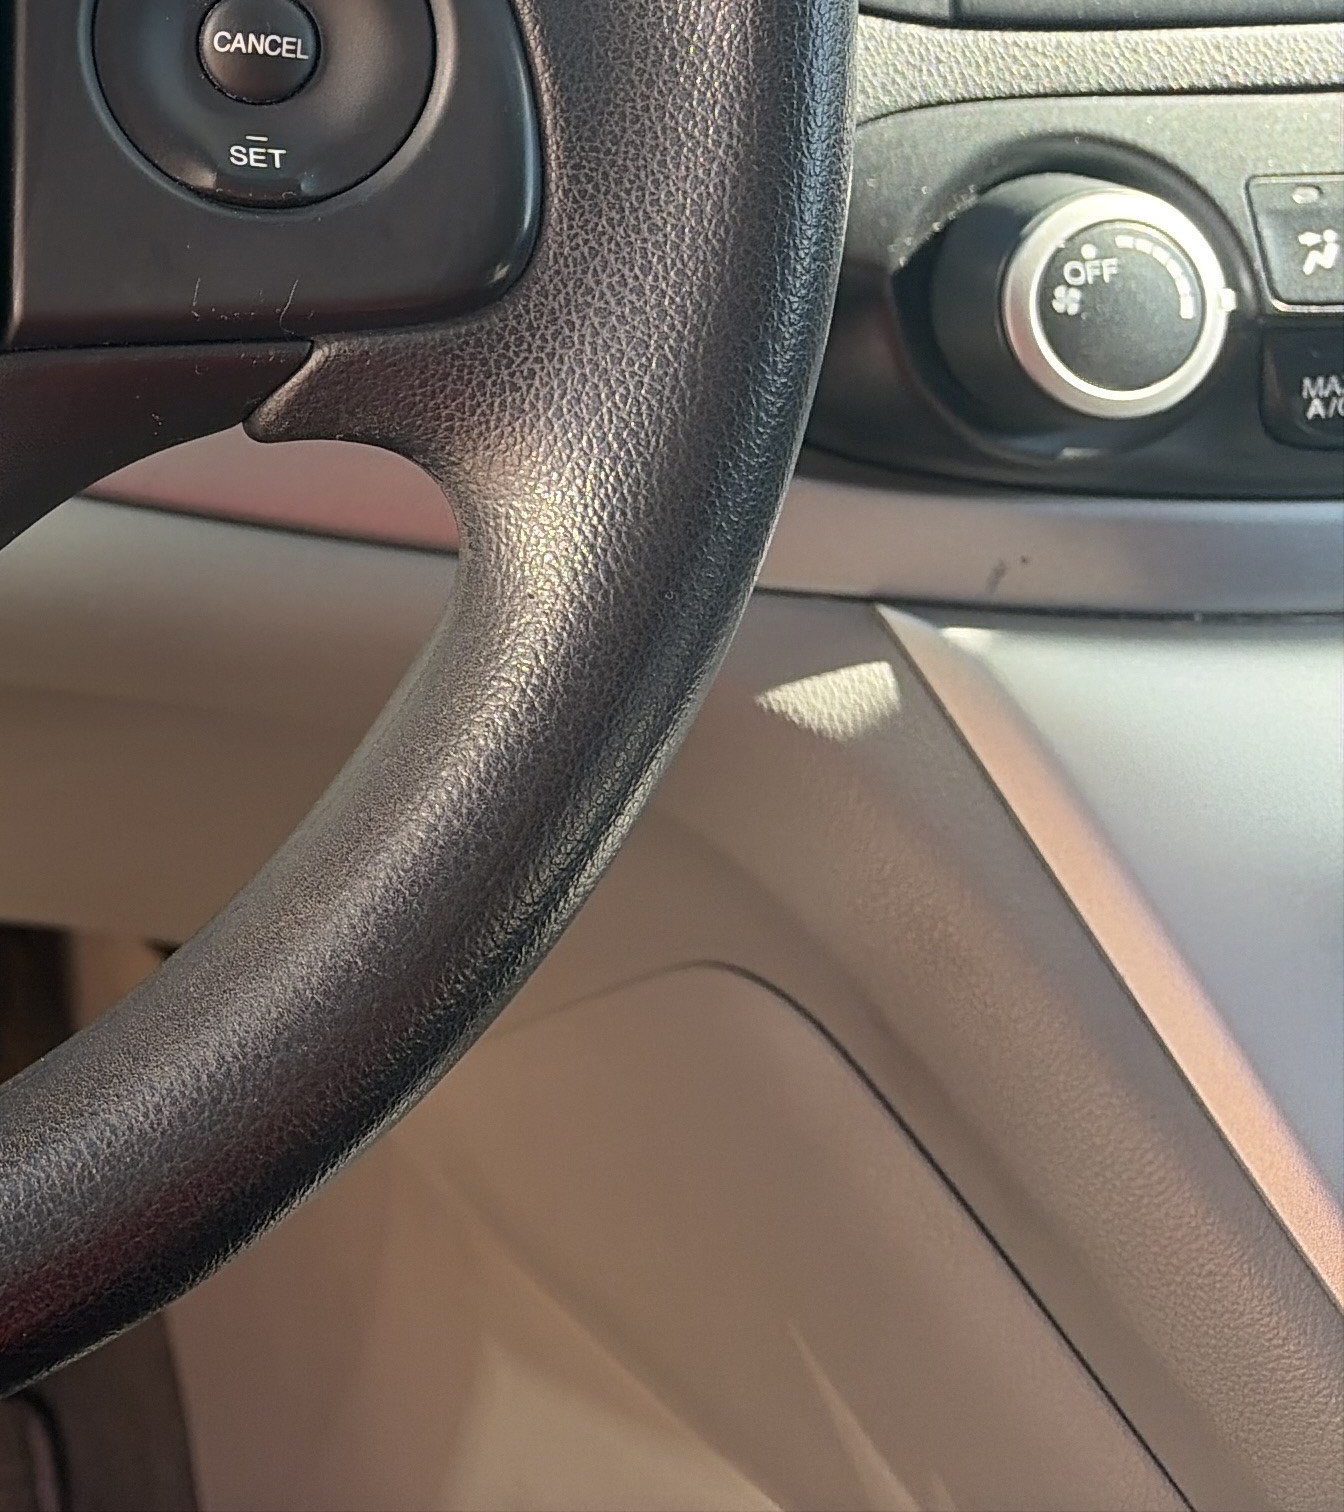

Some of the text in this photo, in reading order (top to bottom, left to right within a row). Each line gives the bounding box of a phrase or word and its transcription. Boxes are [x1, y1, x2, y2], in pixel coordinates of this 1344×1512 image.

[212, 30, 310, 61] CANCEL
[228, 146, 287, 170] SET
[1063, 256, 1121, 287] OFF
[1301, 375, 1344, 400] MA
